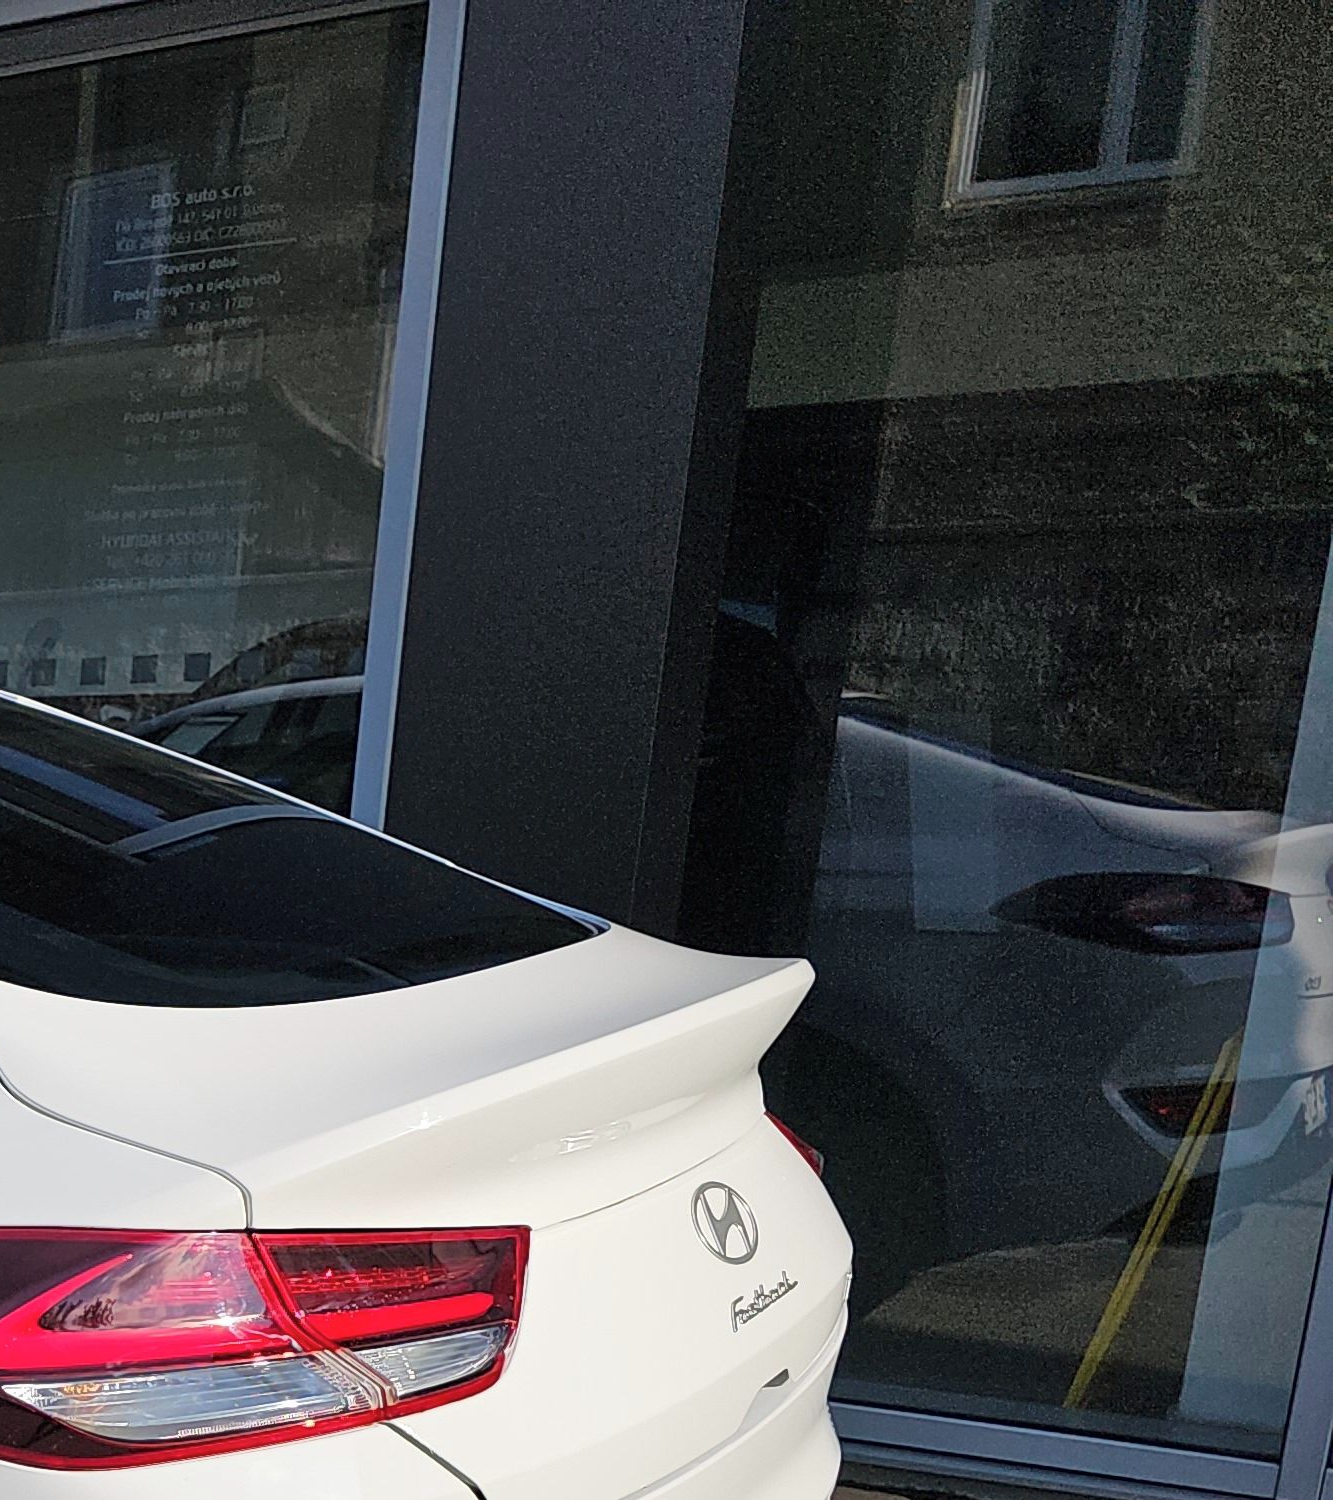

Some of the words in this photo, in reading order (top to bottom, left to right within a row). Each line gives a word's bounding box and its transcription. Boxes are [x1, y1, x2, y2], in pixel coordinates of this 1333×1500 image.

[151, 193, 181, 209] BOS
[185, 188, 217, 205] auto
[730, 1270, 798, 1333] Fastback
